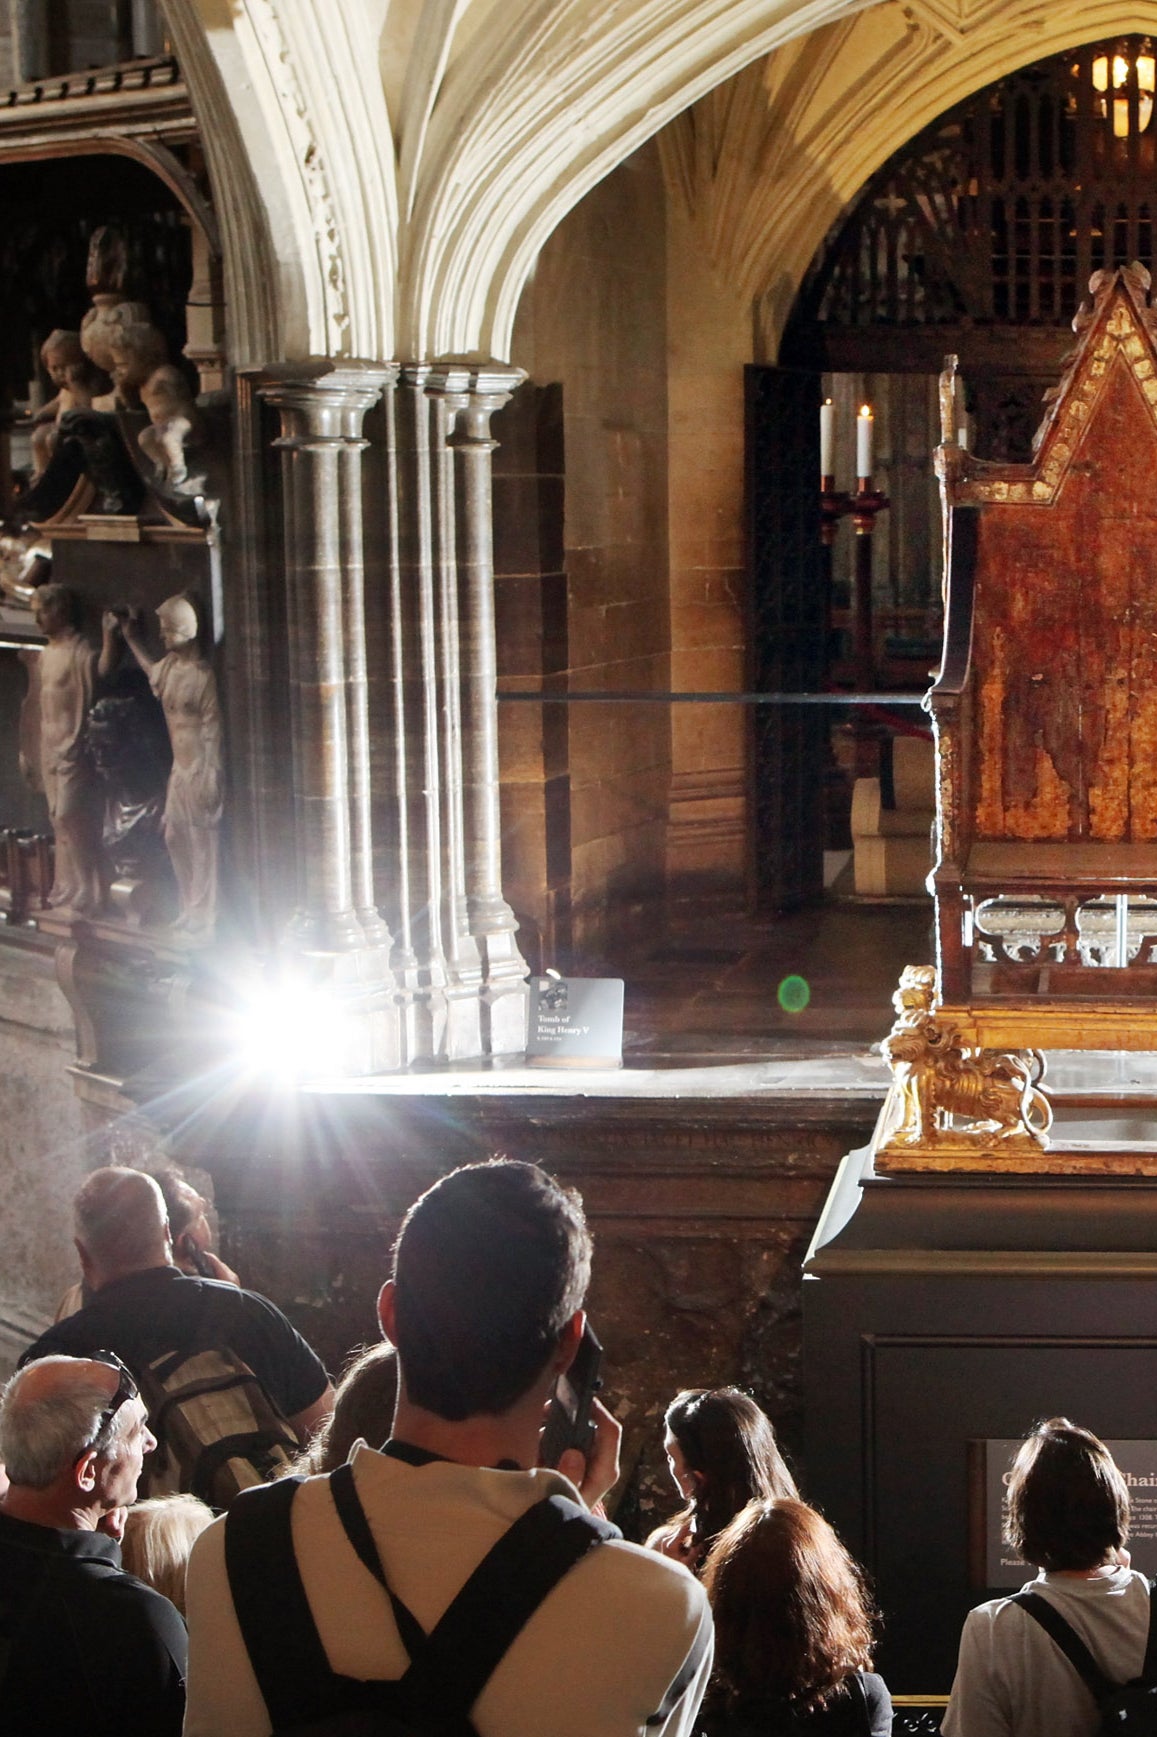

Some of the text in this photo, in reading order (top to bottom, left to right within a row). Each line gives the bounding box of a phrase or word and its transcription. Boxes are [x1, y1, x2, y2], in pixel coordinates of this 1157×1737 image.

[538, 1015, 571, 1023] Tomb of
[538, 1025, 589, 1036] King Henry V
